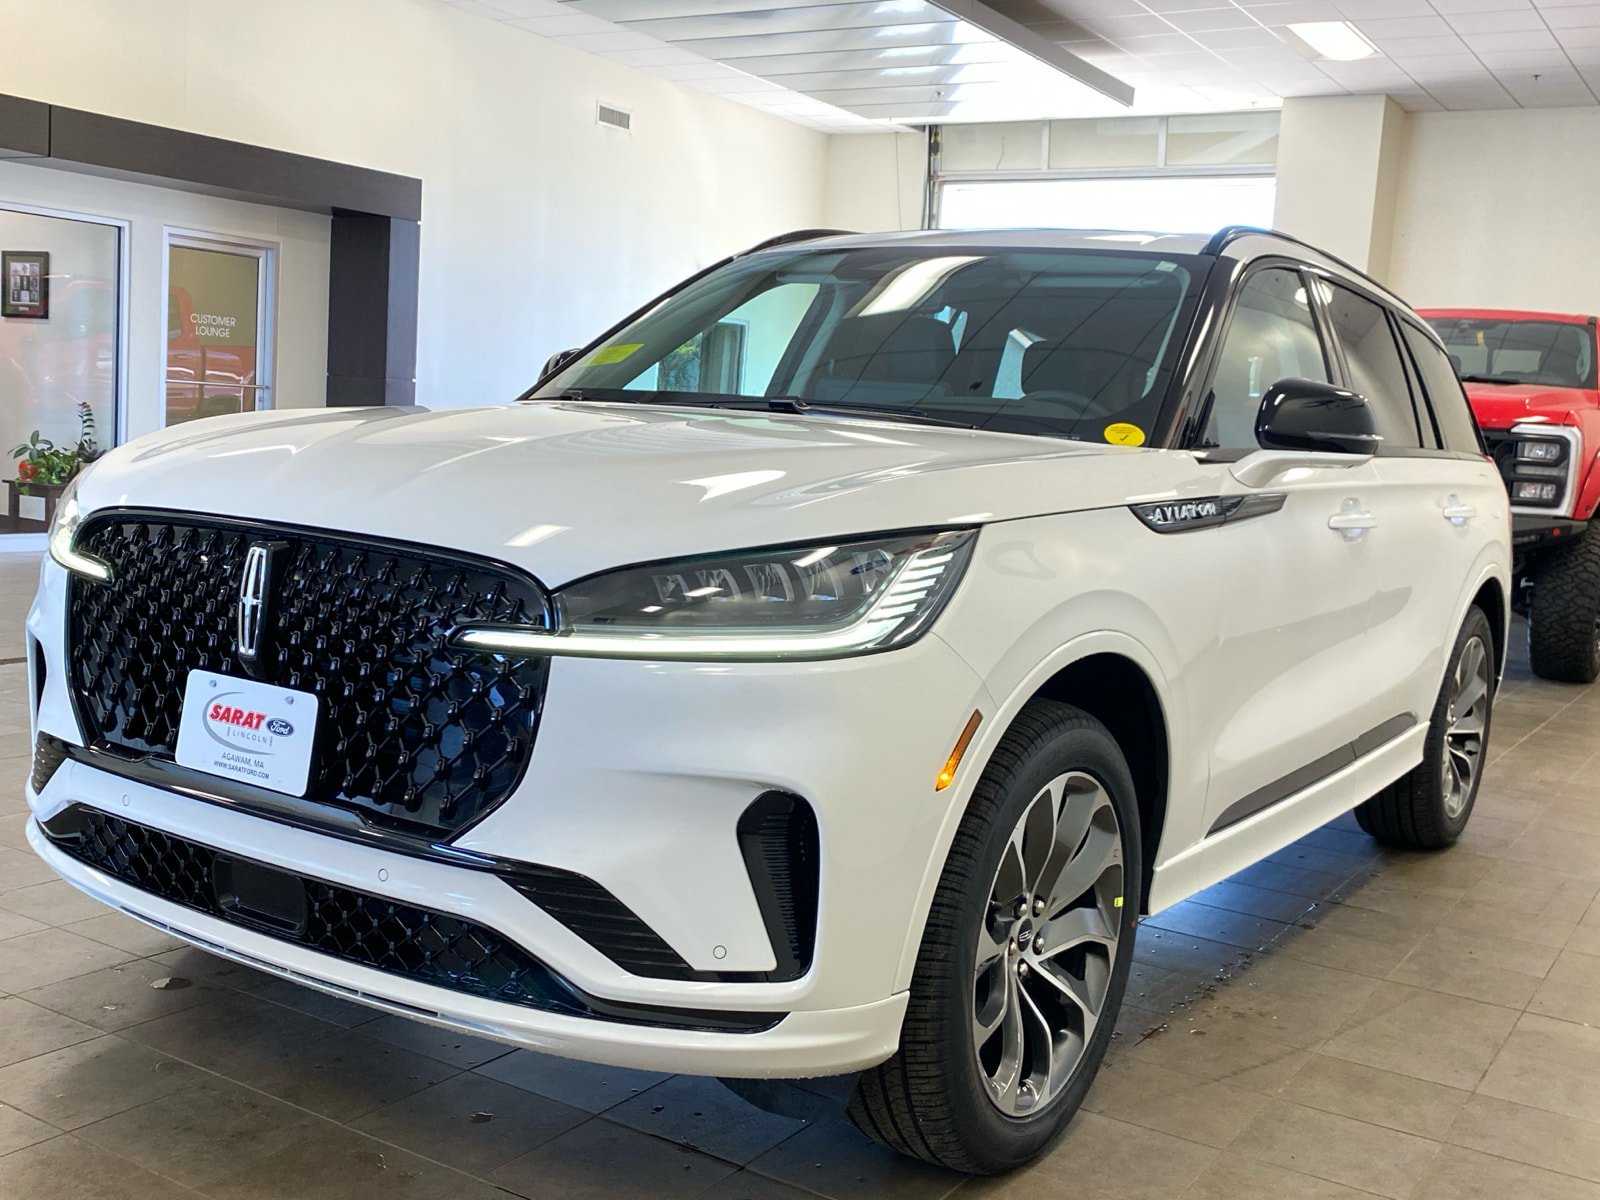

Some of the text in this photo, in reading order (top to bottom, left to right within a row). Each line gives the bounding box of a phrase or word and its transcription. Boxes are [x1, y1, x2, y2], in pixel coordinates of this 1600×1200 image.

[190, 313, 236, 327] CUSTOMER
[195, 325, 230, 338] LOUNGE
[1152, 502, 1217, 521] AVIATOR
[209, 703, 267, 731] SARAT
[269, 720, 291, 735] Ford
[232, 730, 268, 744] LINCOLN
[221, 752, 264, 769] AGAWAM, MA
[213, 760, 270, 779] WWW.SARATFORD.COM
